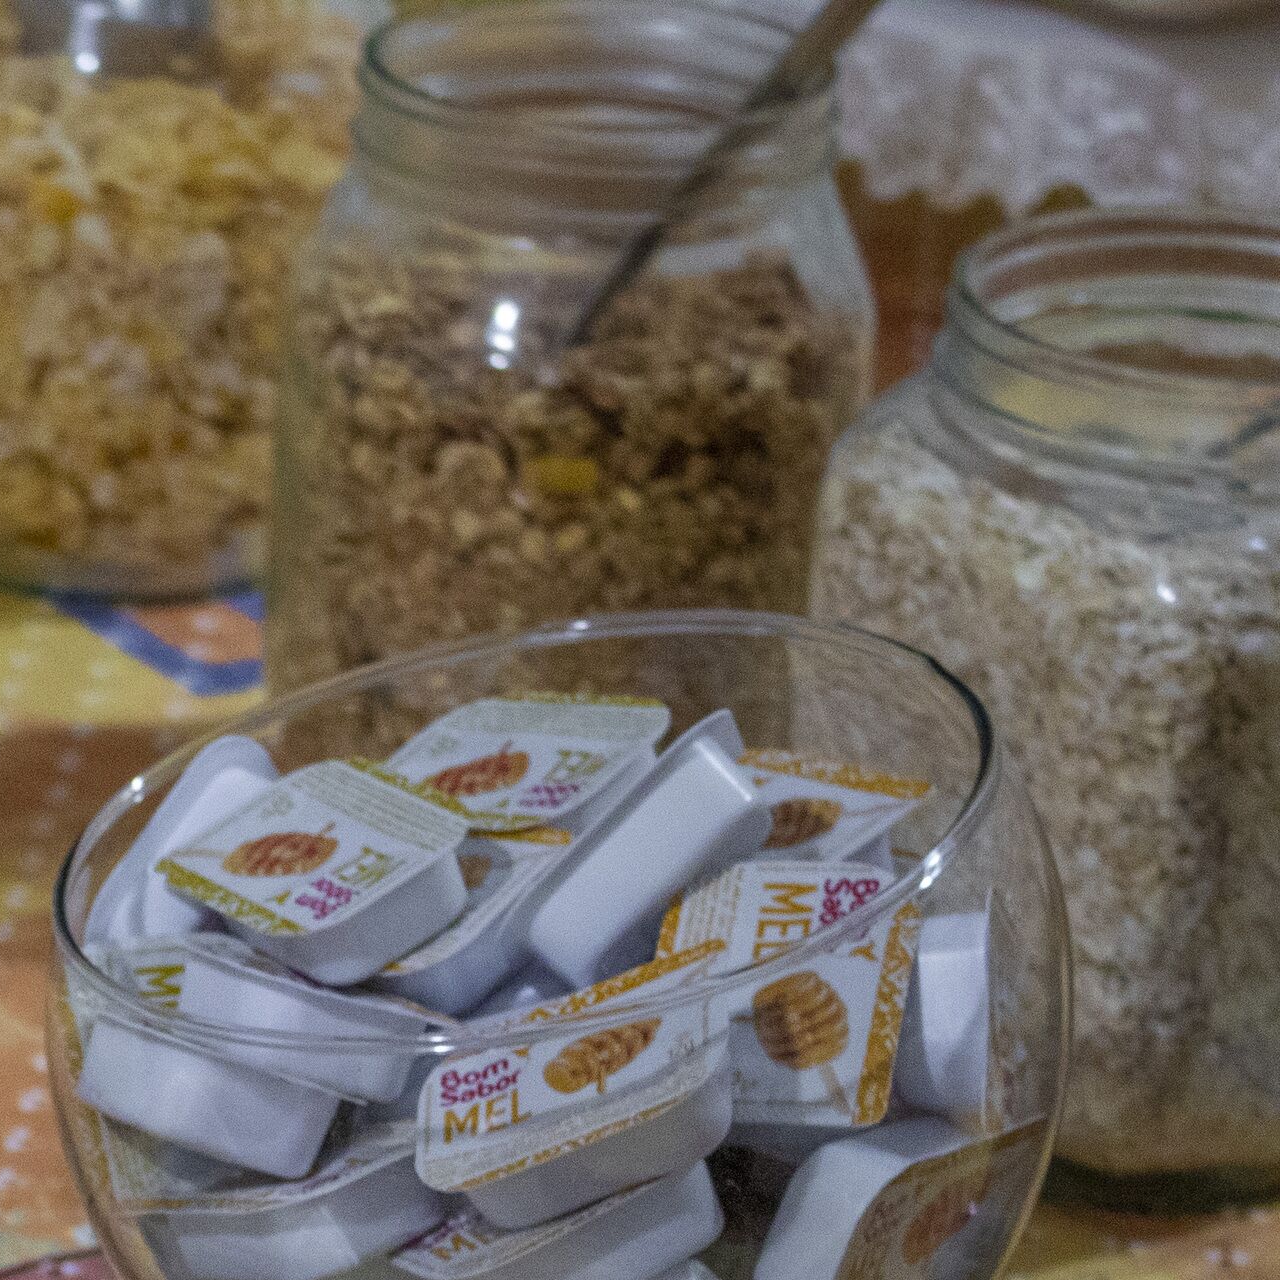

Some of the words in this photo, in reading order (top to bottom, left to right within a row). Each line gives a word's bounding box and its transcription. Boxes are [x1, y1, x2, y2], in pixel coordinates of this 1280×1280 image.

[753, 882, 818, 962] MEL
[440, 1058, 509, 1092] Bom
[441, 1069, 521, 1107] Sabor
[443, 1089, 532, 1145] MEL
